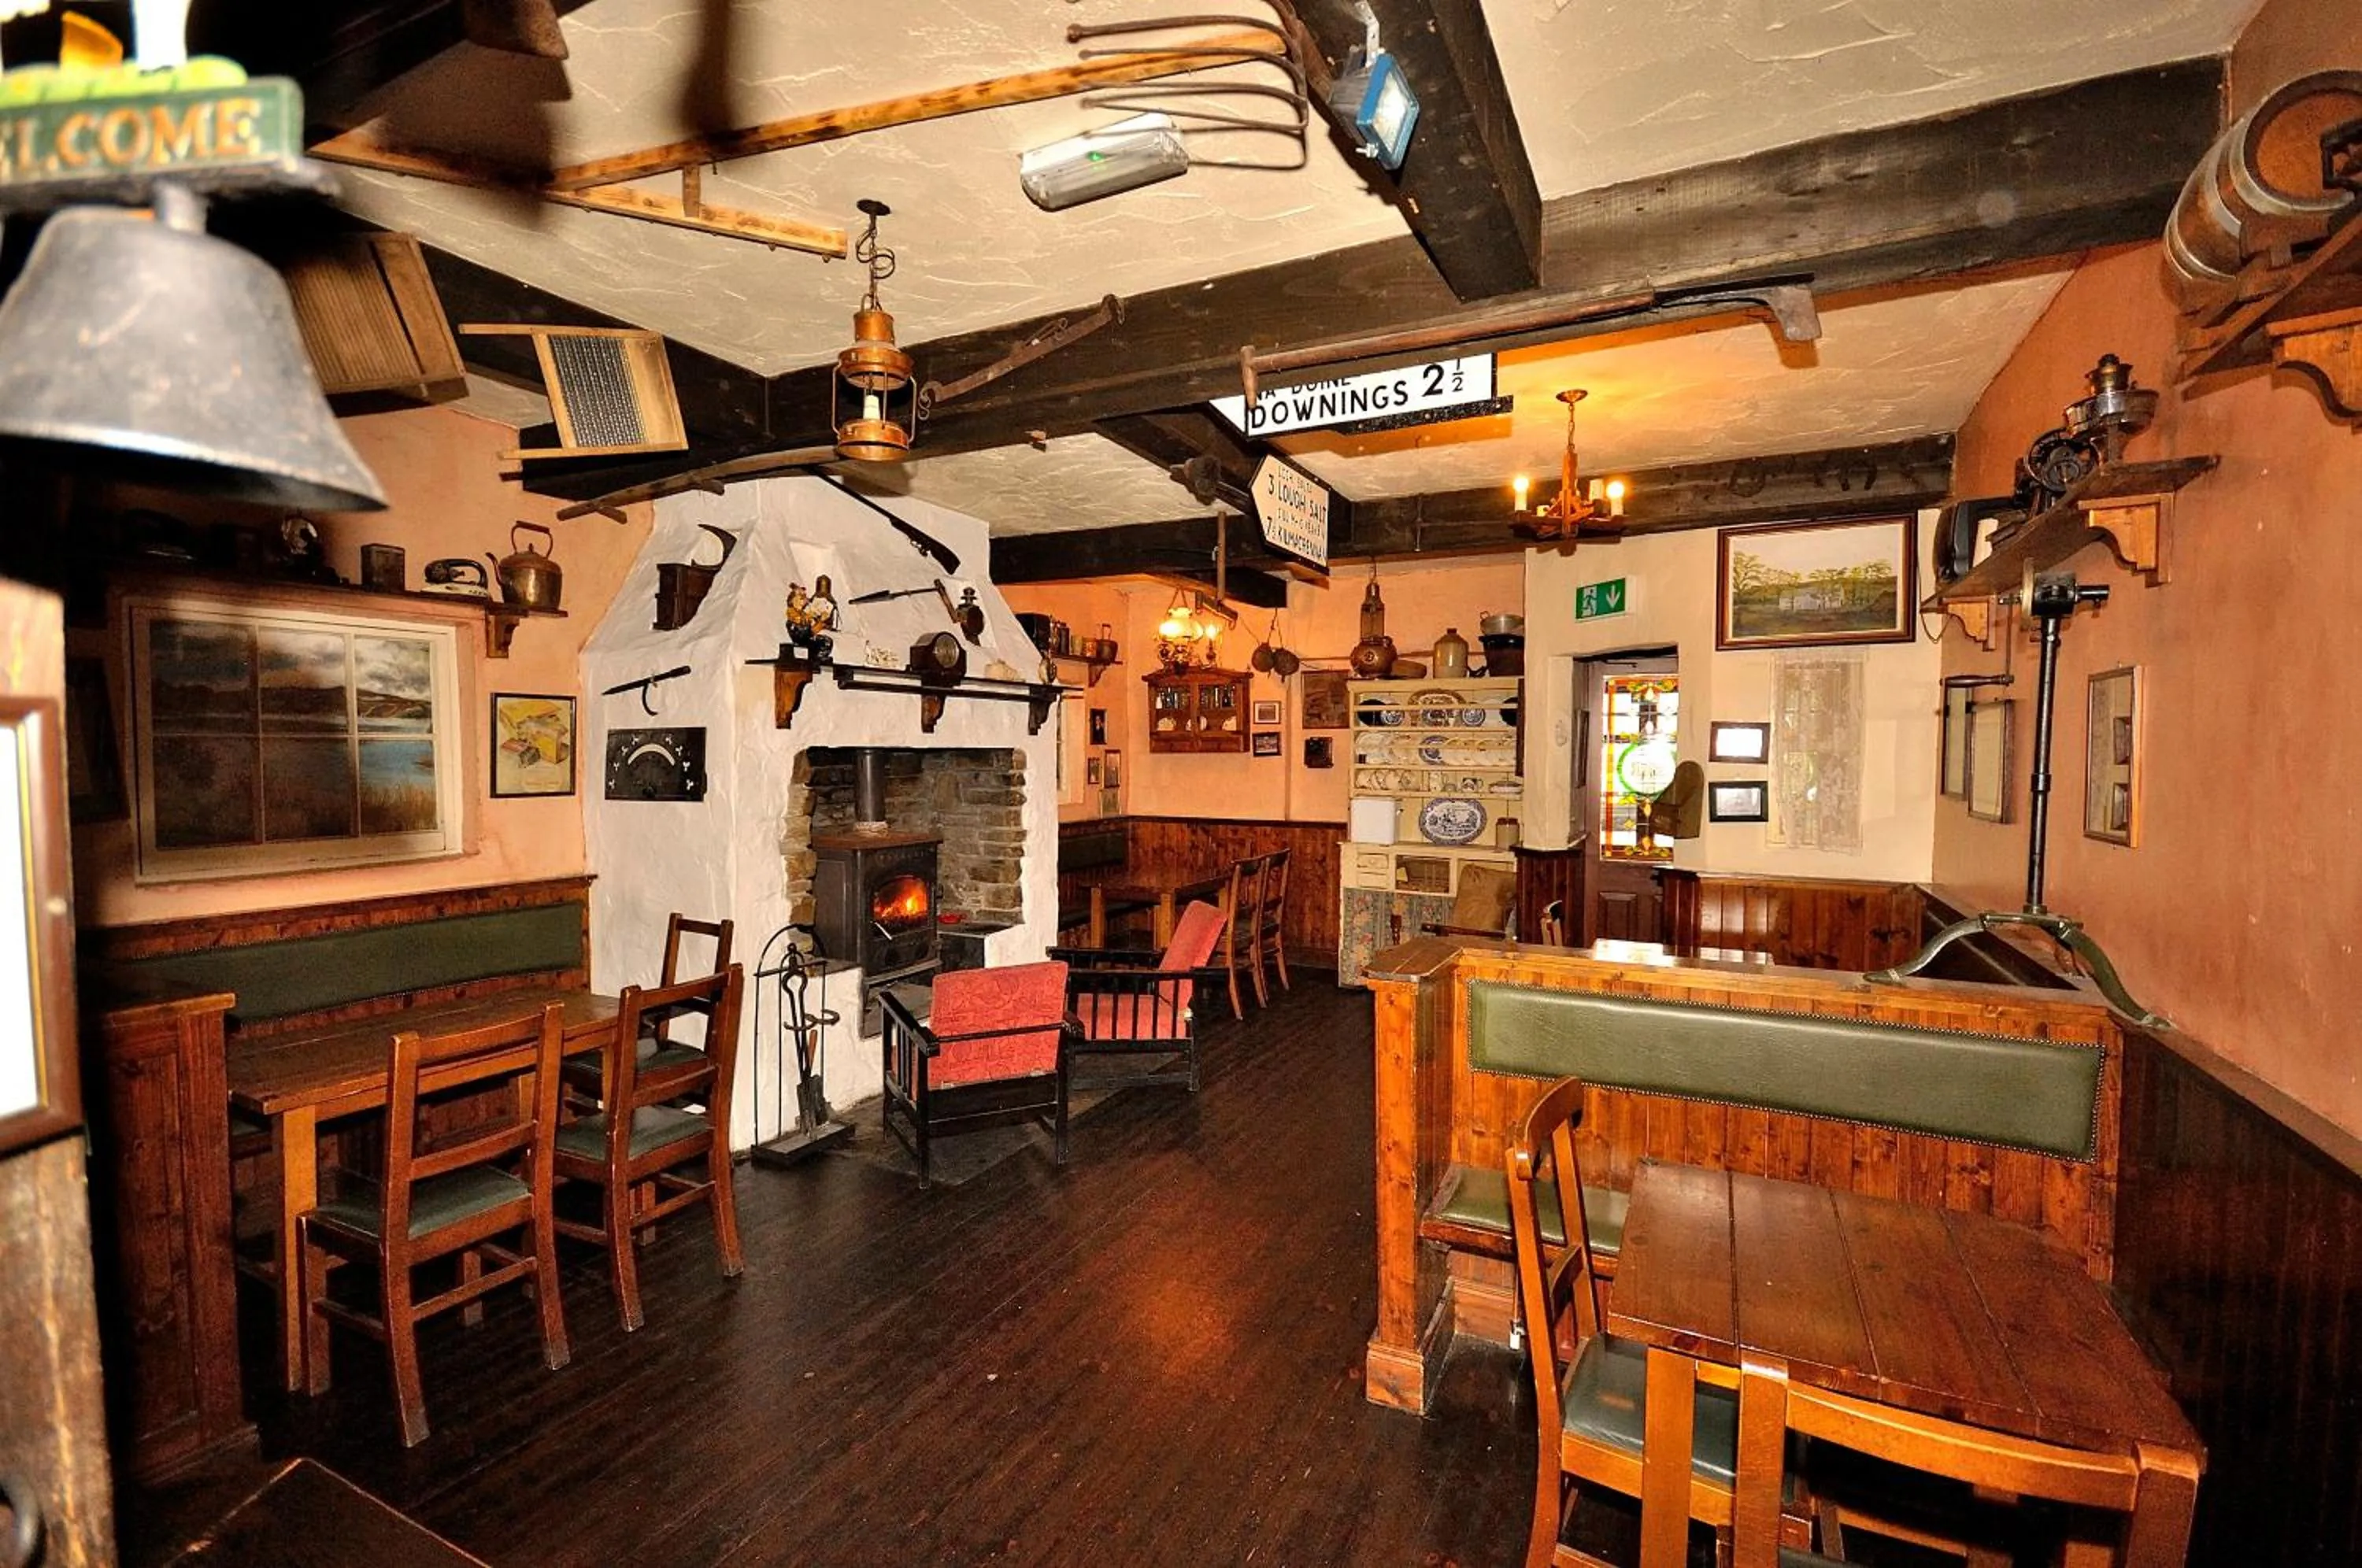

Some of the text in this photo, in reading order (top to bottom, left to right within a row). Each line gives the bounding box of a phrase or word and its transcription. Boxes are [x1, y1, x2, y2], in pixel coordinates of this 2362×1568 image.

[1251, 380, 1409, 429] DOWNINGS
[1268, 474, 1275, 495] 3
[1278, 480, 1306, 512] LOUGH
